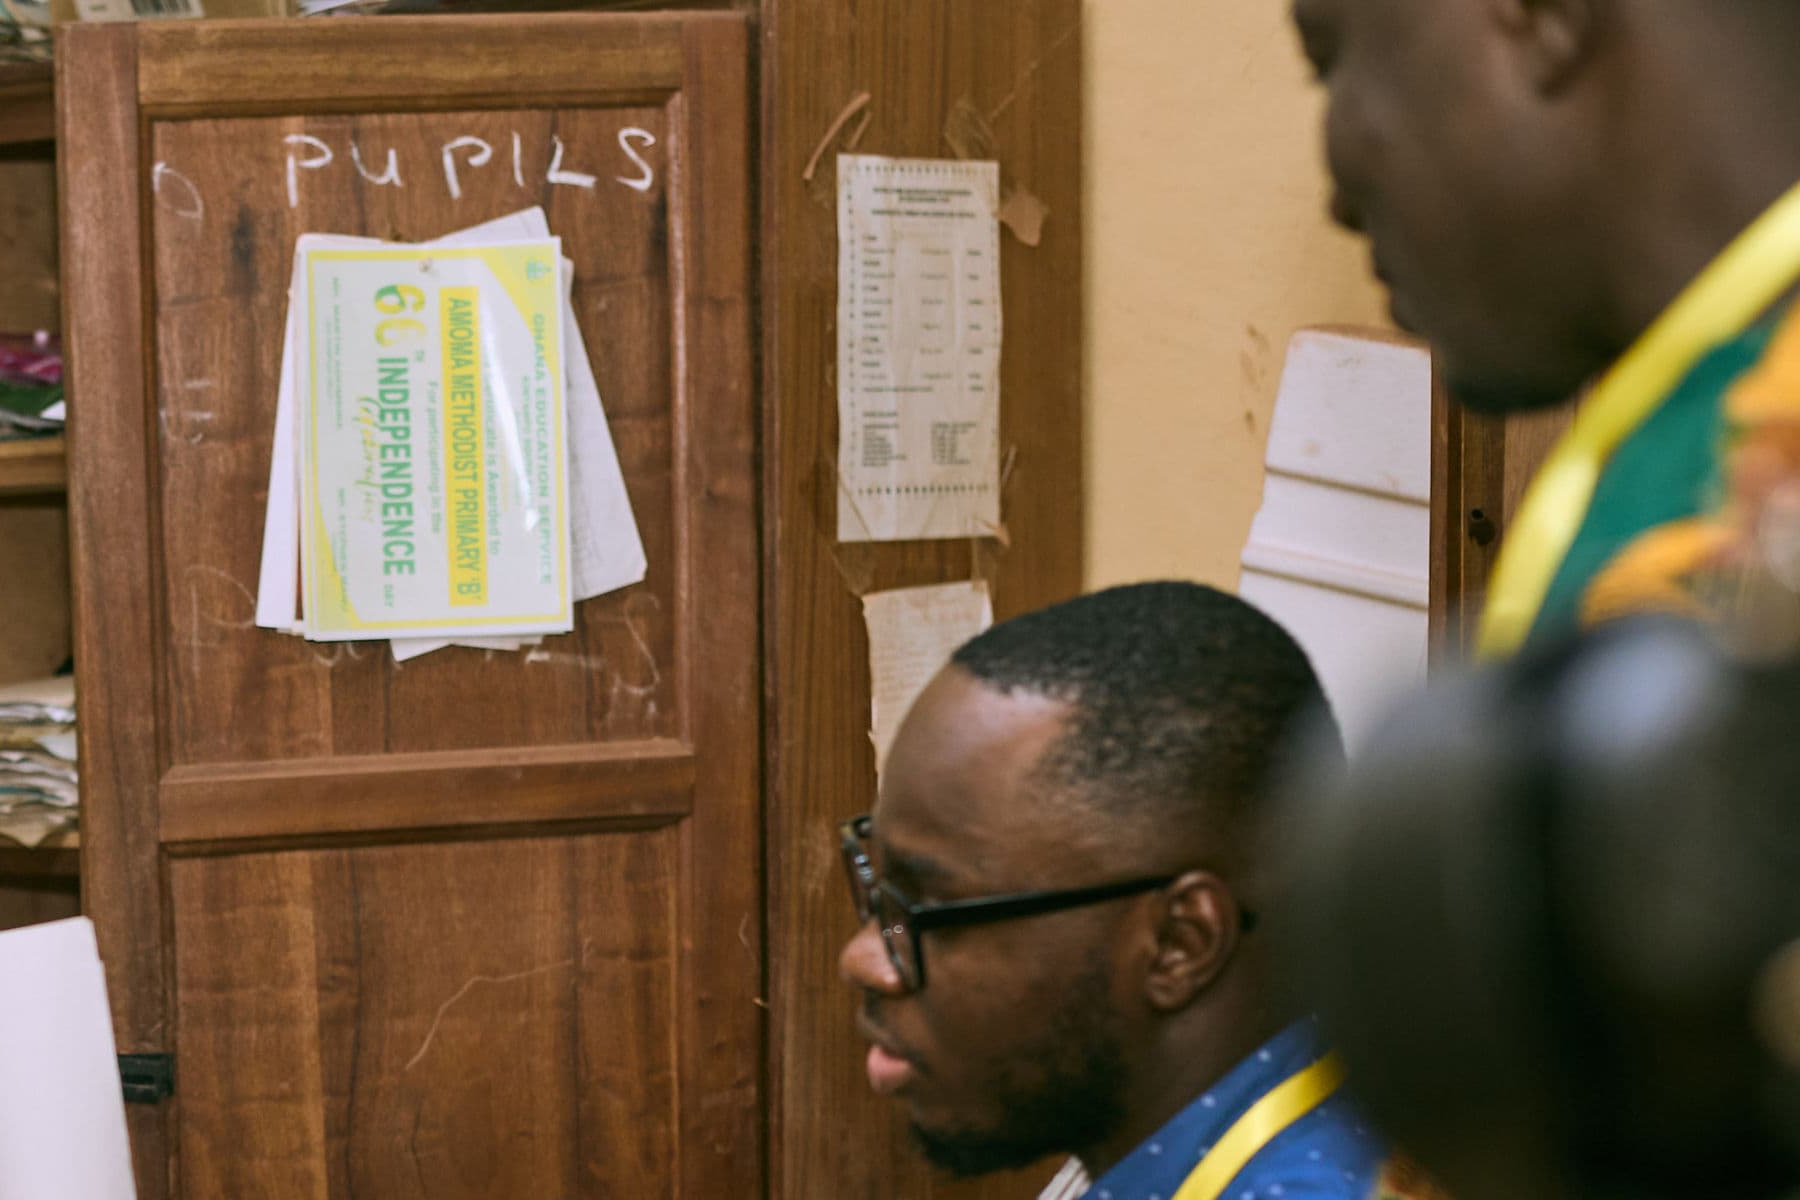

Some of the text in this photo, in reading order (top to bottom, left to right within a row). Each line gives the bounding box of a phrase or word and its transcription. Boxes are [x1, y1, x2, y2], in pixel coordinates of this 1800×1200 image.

[284, 127, 655, 208] PUPILS
[448, 297, 473, 369] AMOMA
[377, 357, 415, 575] INDEPENDENCE
[426, 381, 441, 534] For participating in the
[450, 375, 479, 482] METHODIST
[533, 312, 552, 584] GHANA EDUCATION SERVICE
[455, 488, 481, 572] PRIMARY
[487, 471, 500, 537] Awarded
[489, 541, 500, 556] to
